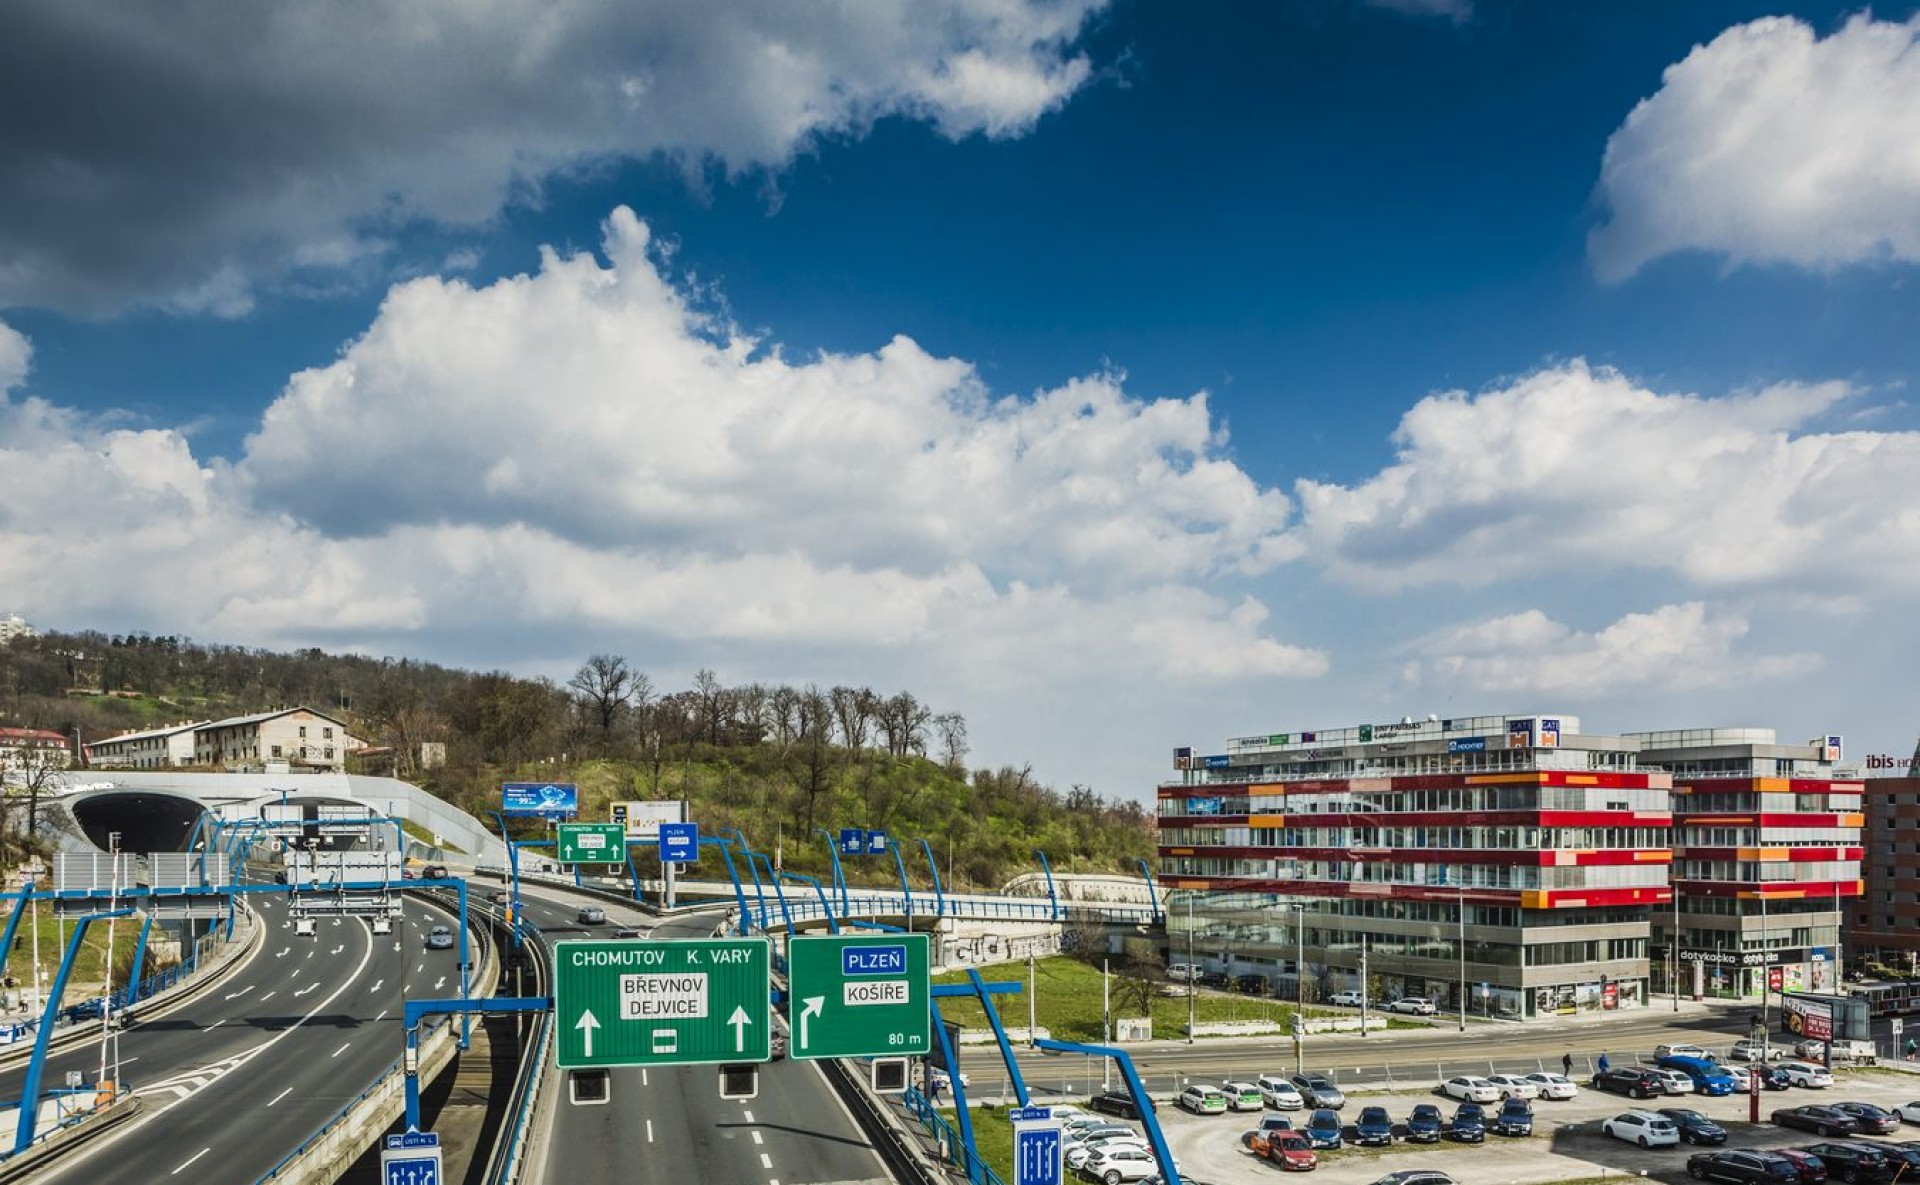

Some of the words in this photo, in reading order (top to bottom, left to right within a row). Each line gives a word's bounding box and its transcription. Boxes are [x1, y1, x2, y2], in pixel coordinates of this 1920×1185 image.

[1542, 721, 1560, 730] GATE
[1457, 742, 1485, 750] HOCHTIEF
[1866, 754, 1894, 769] ibis
[572, 950, 665, 967] CHOMUTOV
[687, 949, 703, 964] K.
[710, 948, 752, 964] VARY
[848, 951, 900, 969] PLZEŇ
[624, 976, 704, 994] BŘEVNOV
[848, 983, 905, 1001] KOŠÍŘE
[630, 999, 698, 1015] DEJVICE
[888, 1033, 904, 1045] 80
[909, 1035, 921, 1044] m
